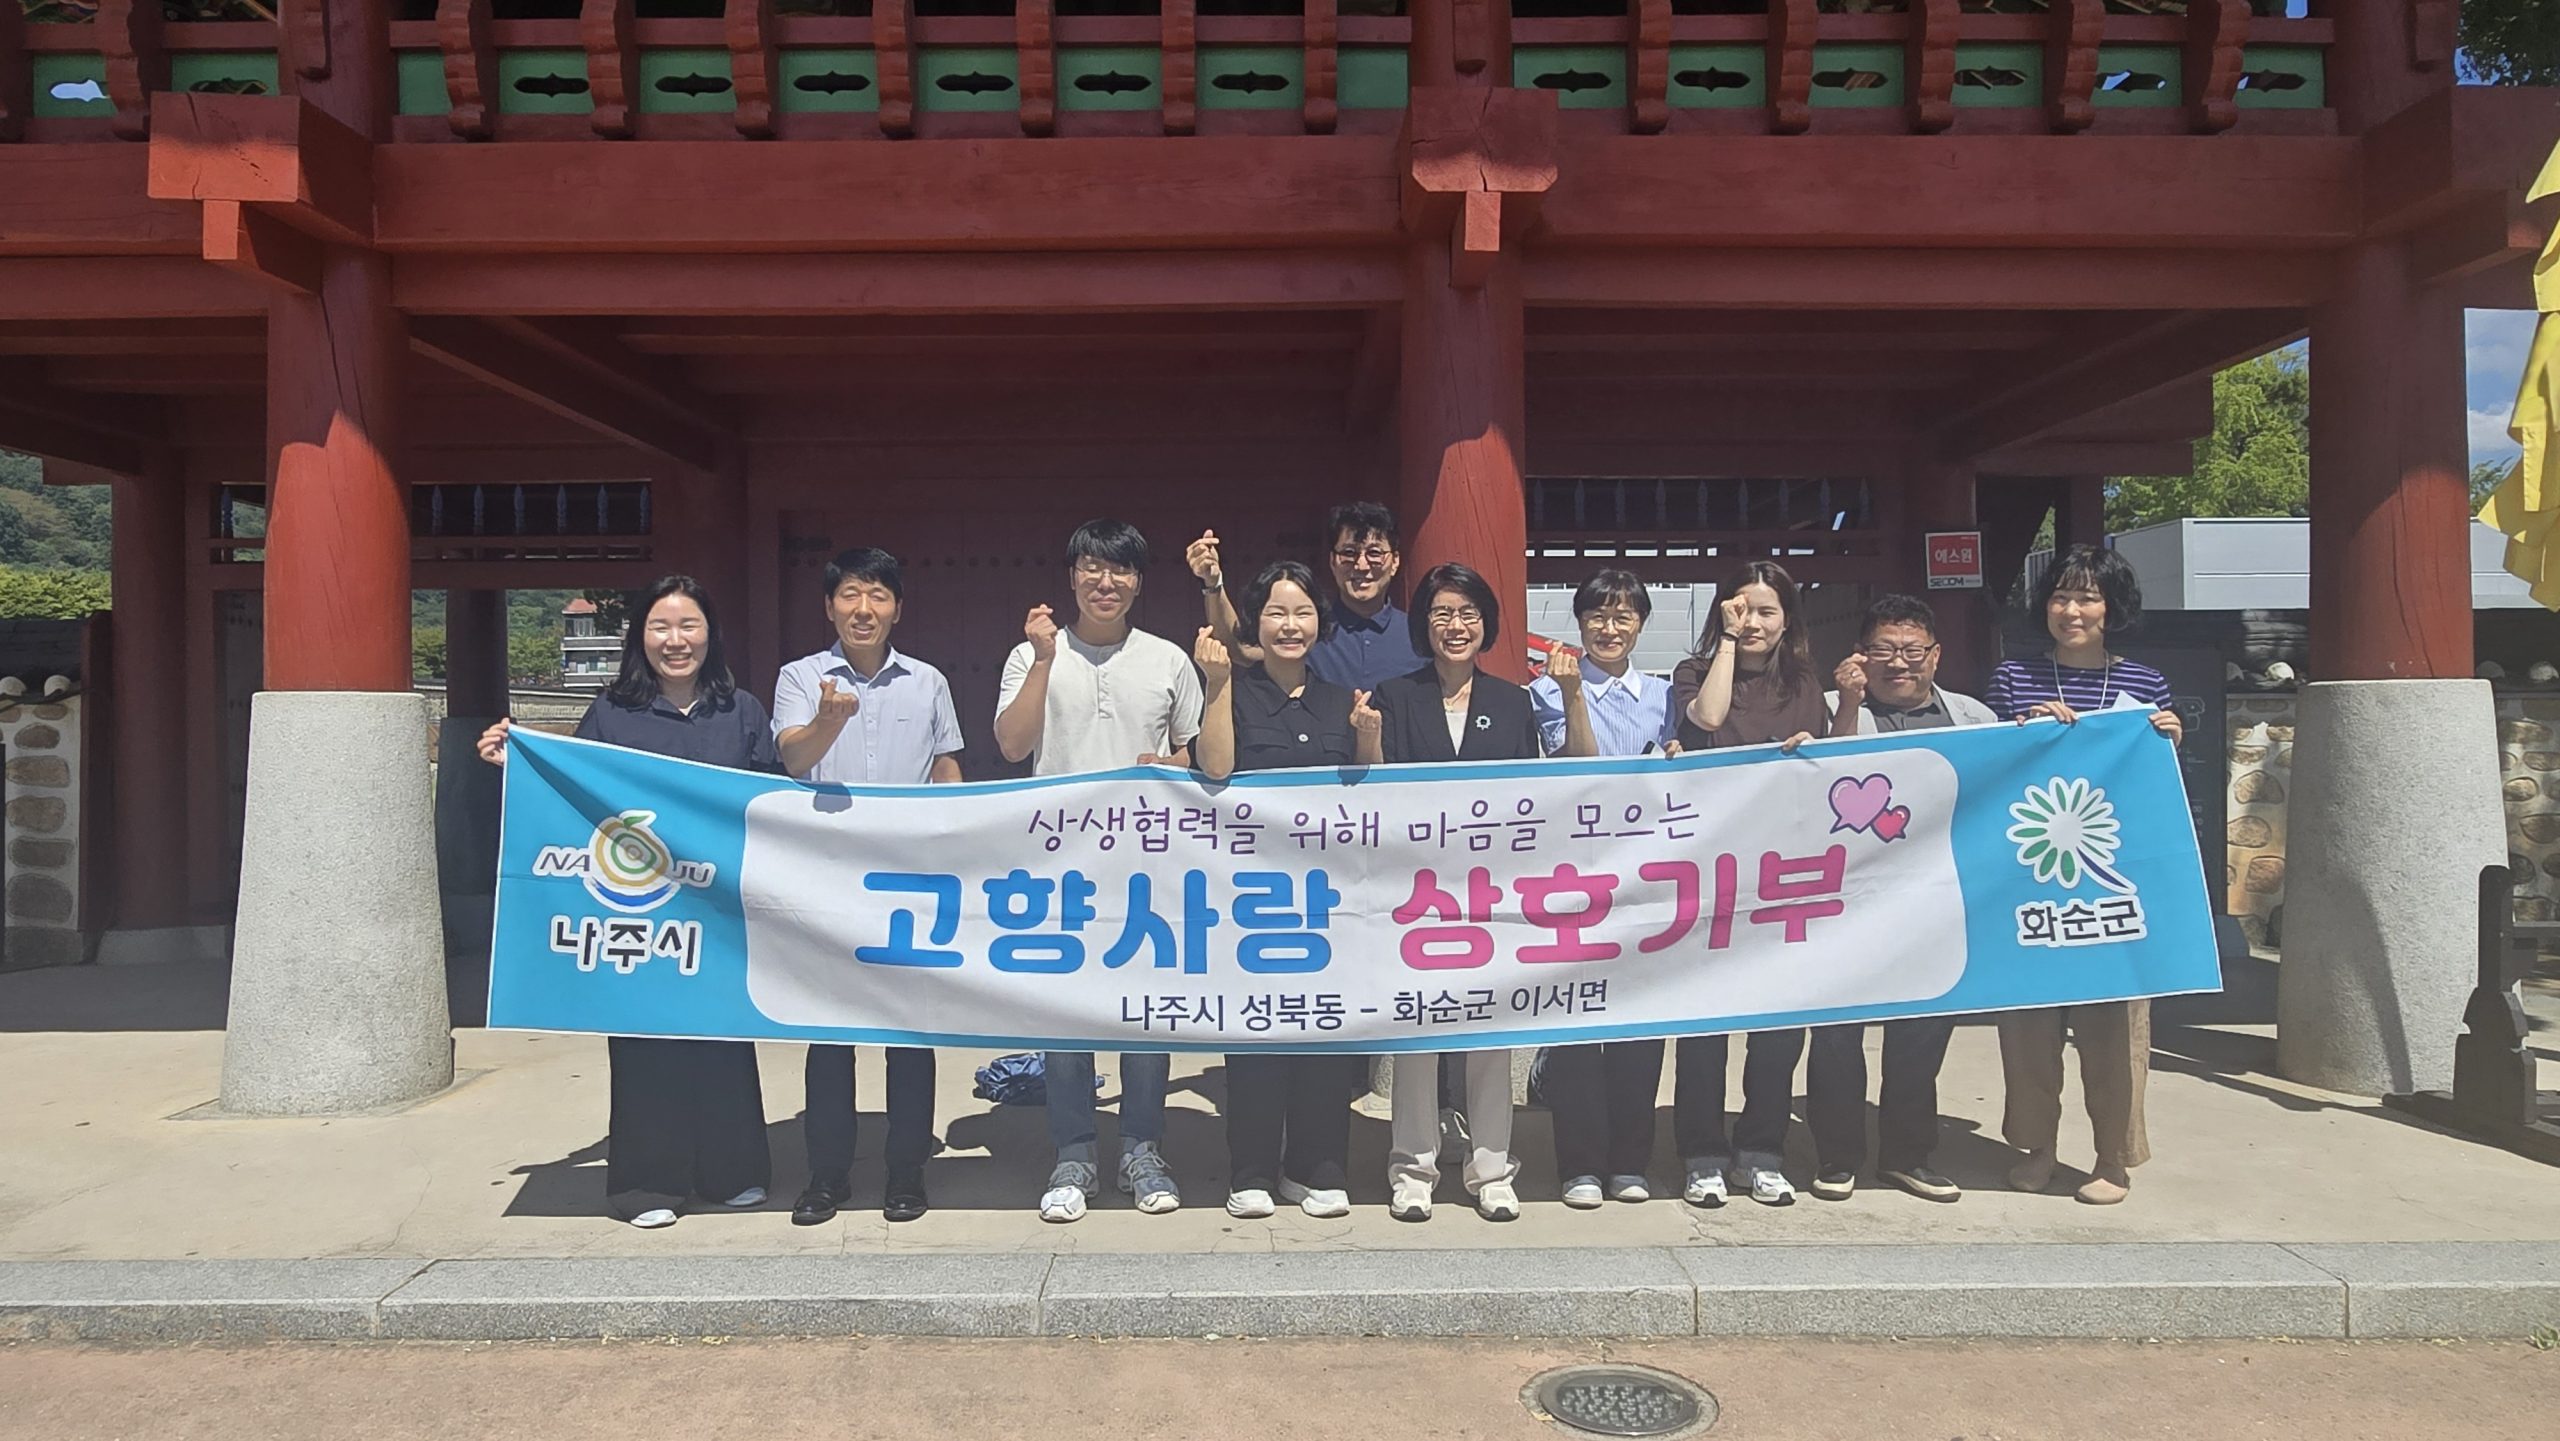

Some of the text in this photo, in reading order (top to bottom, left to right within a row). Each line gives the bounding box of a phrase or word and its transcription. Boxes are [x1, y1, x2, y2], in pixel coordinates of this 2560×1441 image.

[1934, 547, 1972, 564] 에스원
[1028, 791, 1701, 854] 상생협력을 위해 마음을 모으는
[854, 842, 1848, 975] 고향사랑 상호기부
[2021, 900, 2140, 941] 화순군
[556, 921, 697, 969] 나주시
[1121, 994, 1225, 1032] 나주시
[1239, 993, 1347, 1032] 성북동
[1392, 987, 1498, 1026] 화순군
[1509, 978, 1609, 1017] 이서면
